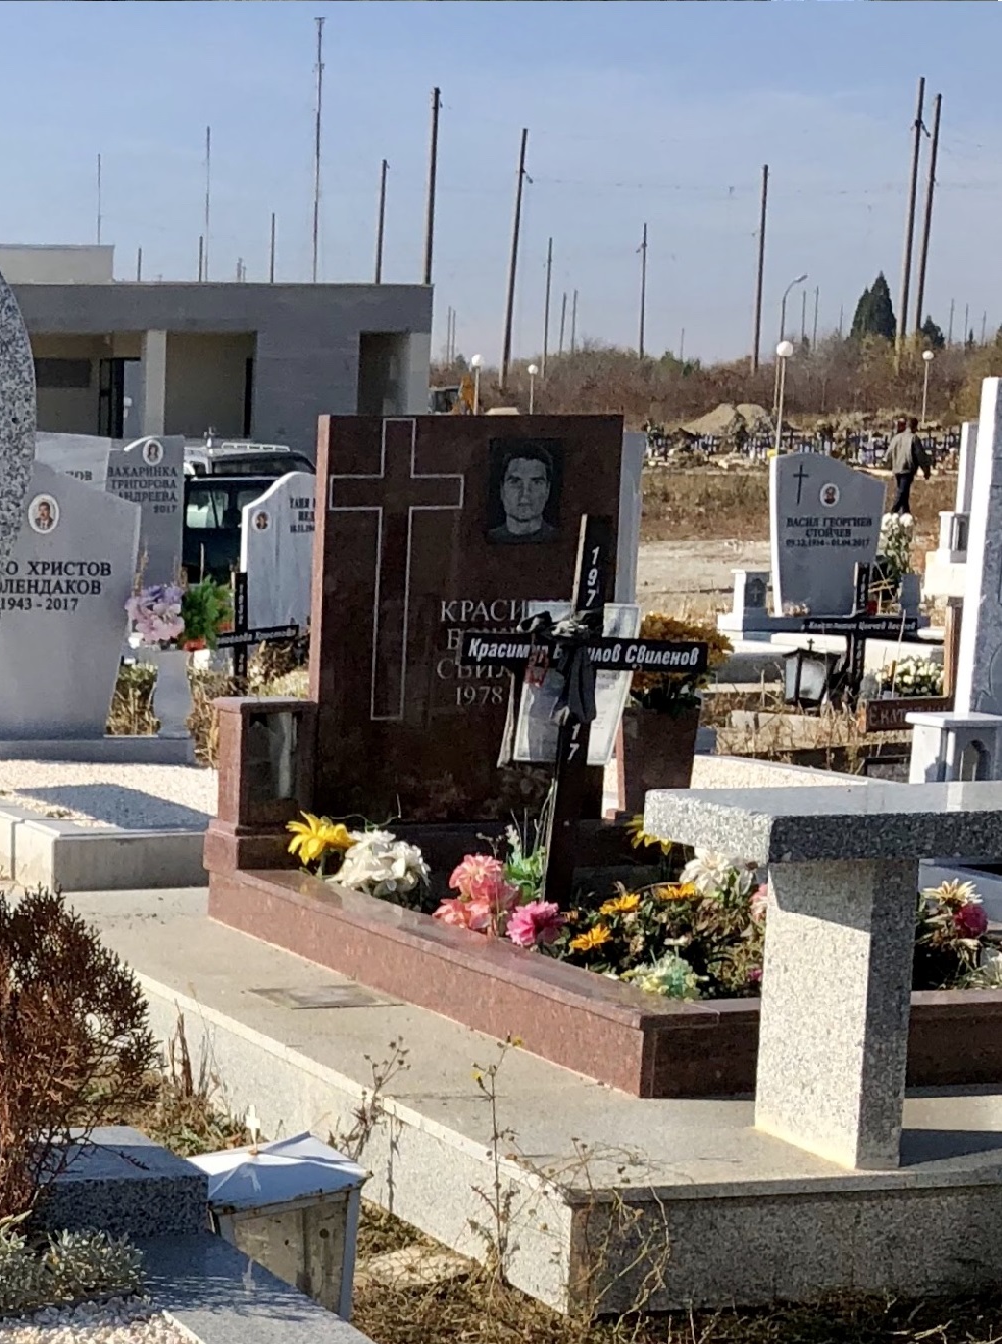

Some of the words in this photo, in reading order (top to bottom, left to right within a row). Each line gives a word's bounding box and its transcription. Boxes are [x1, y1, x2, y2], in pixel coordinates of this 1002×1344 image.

[26, 561, 112, 576] ХРИСТОВ
[585, 545, 601, 608] 197
[0, 597, 32, 611] 1943
[45, 598, 79, 611] 2017
[440, 599, 527, 623] КРАСИ
[624, 644, 700, 666] Свиленов
[455, 685, 503, 706] 1978
